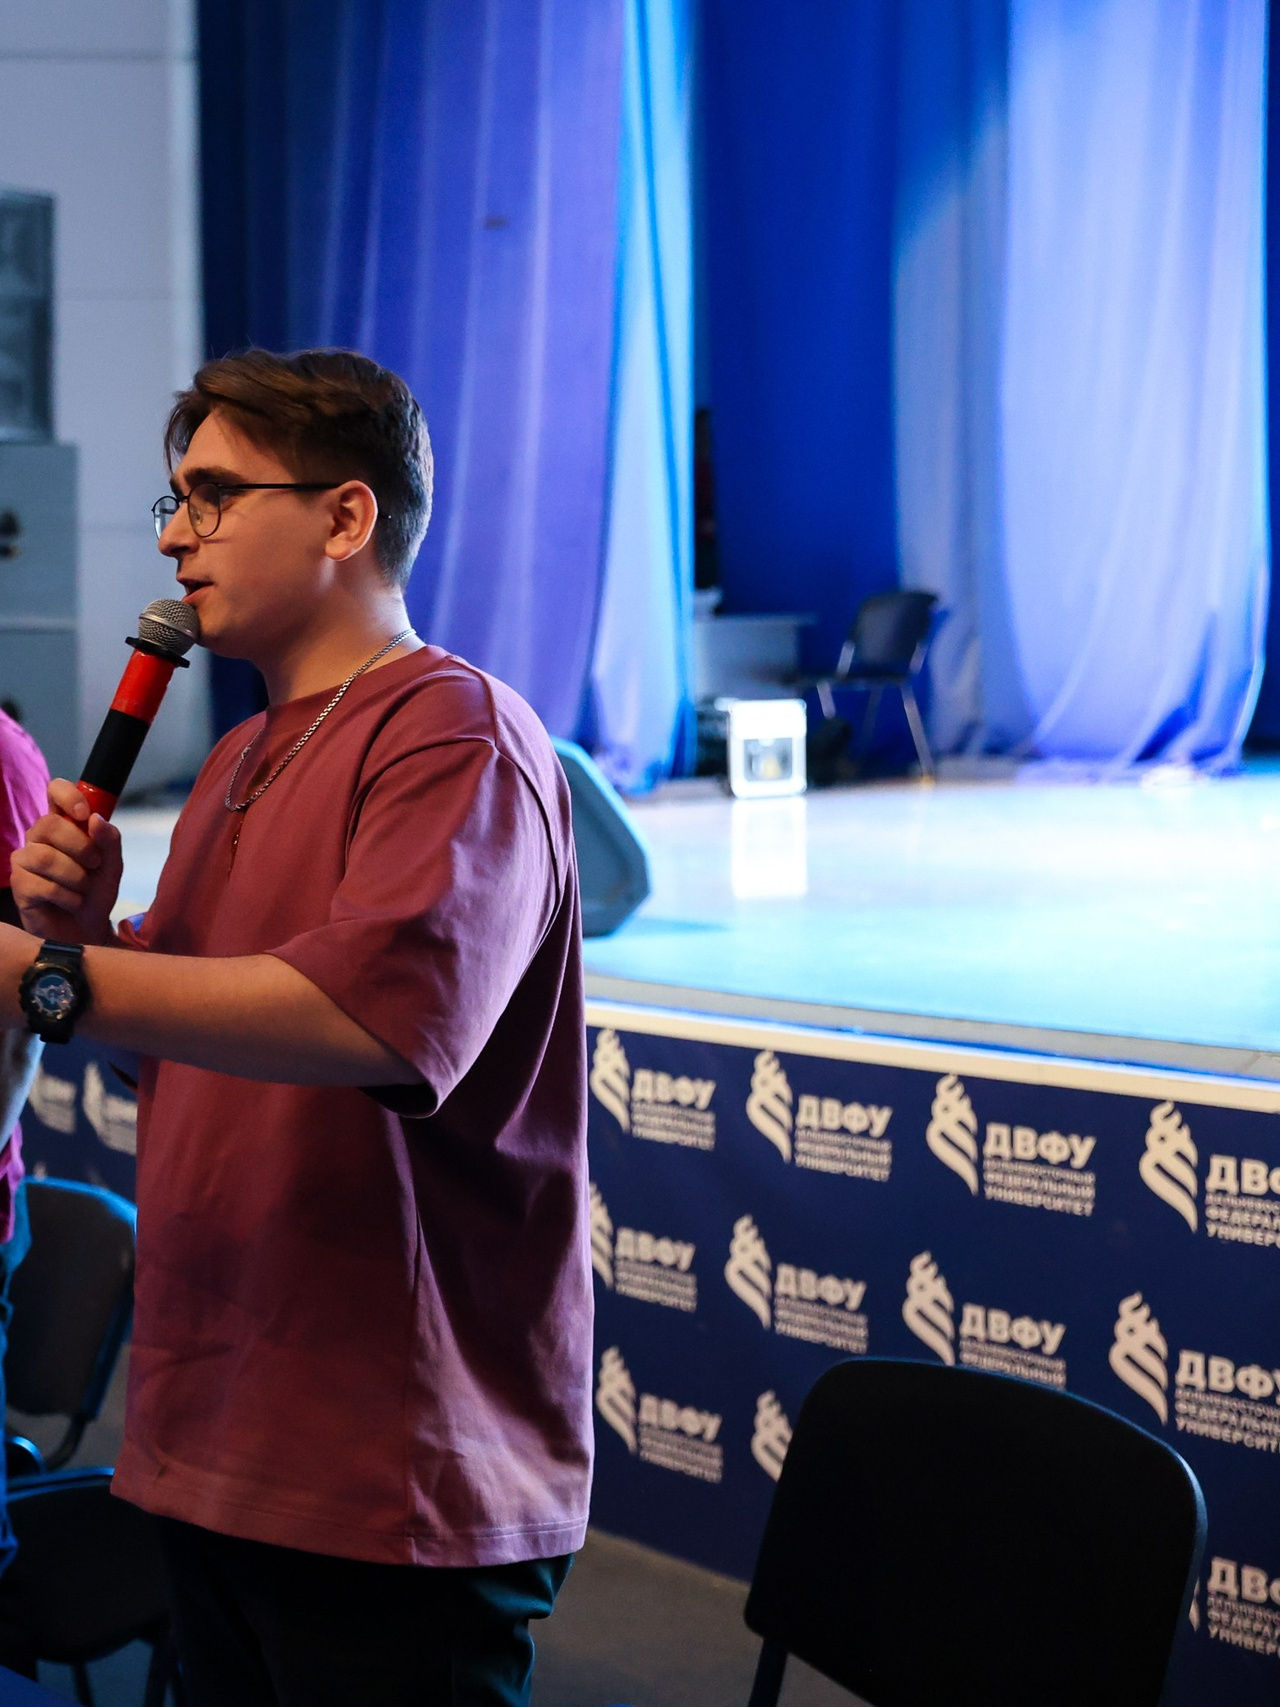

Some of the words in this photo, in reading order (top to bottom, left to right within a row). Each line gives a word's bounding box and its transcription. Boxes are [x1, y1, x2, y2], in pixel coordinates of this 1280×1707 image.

[795, 1094, 892, 1138] ДВФУ
[983, 1122, 1097, 1169] ДВФУ
[774, 1262, 867, 1311] ДВФУ
[960, 1302, 1066, 1355] ДВФУ
[1207, 1624, 1280, 1659] УНИВЕР
